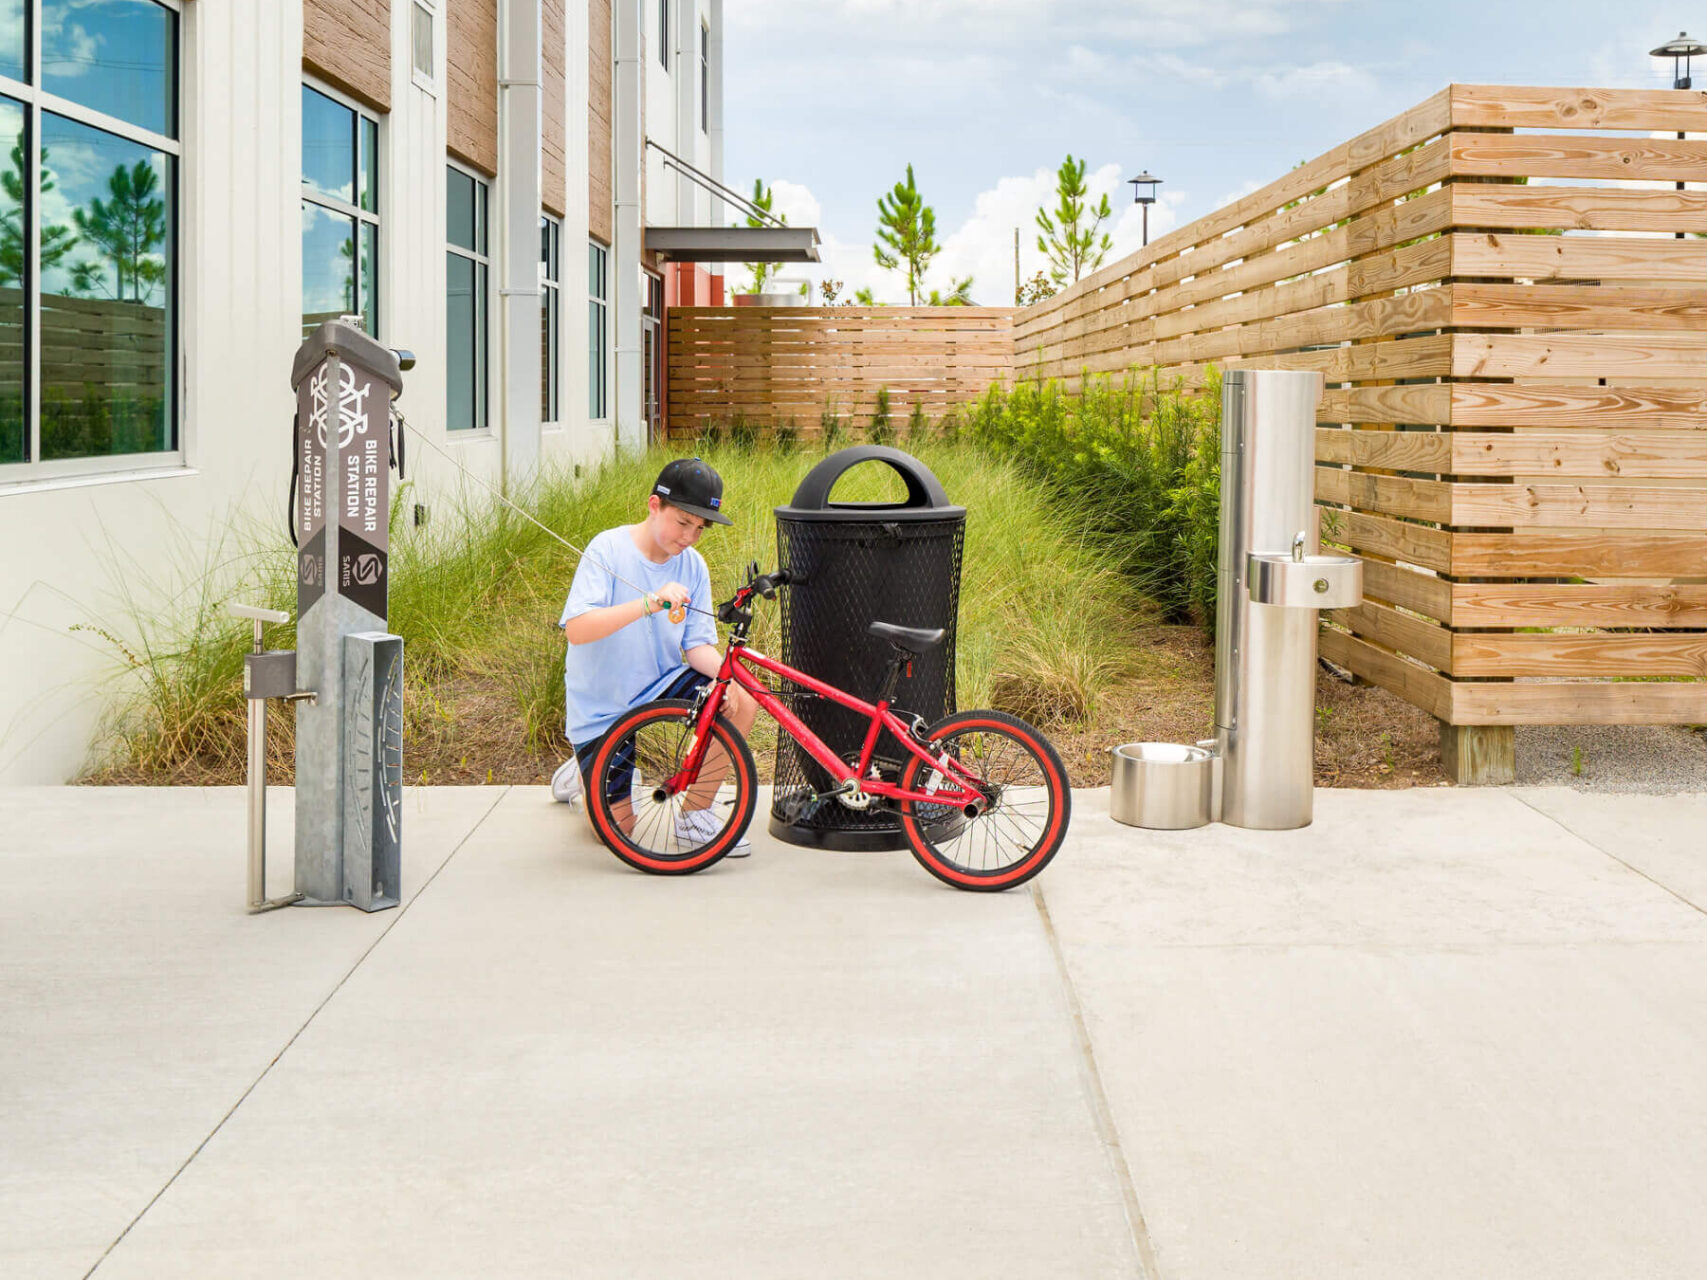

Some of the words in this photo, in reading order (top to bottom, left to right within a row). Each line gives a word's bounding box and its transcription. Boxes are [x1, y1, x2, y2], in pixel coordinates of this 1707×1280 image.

[303, 439, 312, 493] REPAIR
[364, 439, 377, 475] BIKE
[303, 495, 312, 532] BIKE
[313, 455, 322, 518] STATION
[347, 455, 360, 518] STATION
[364, 477, 377, 532] REPAIR
[342, 554, 351, 587] SARIS
